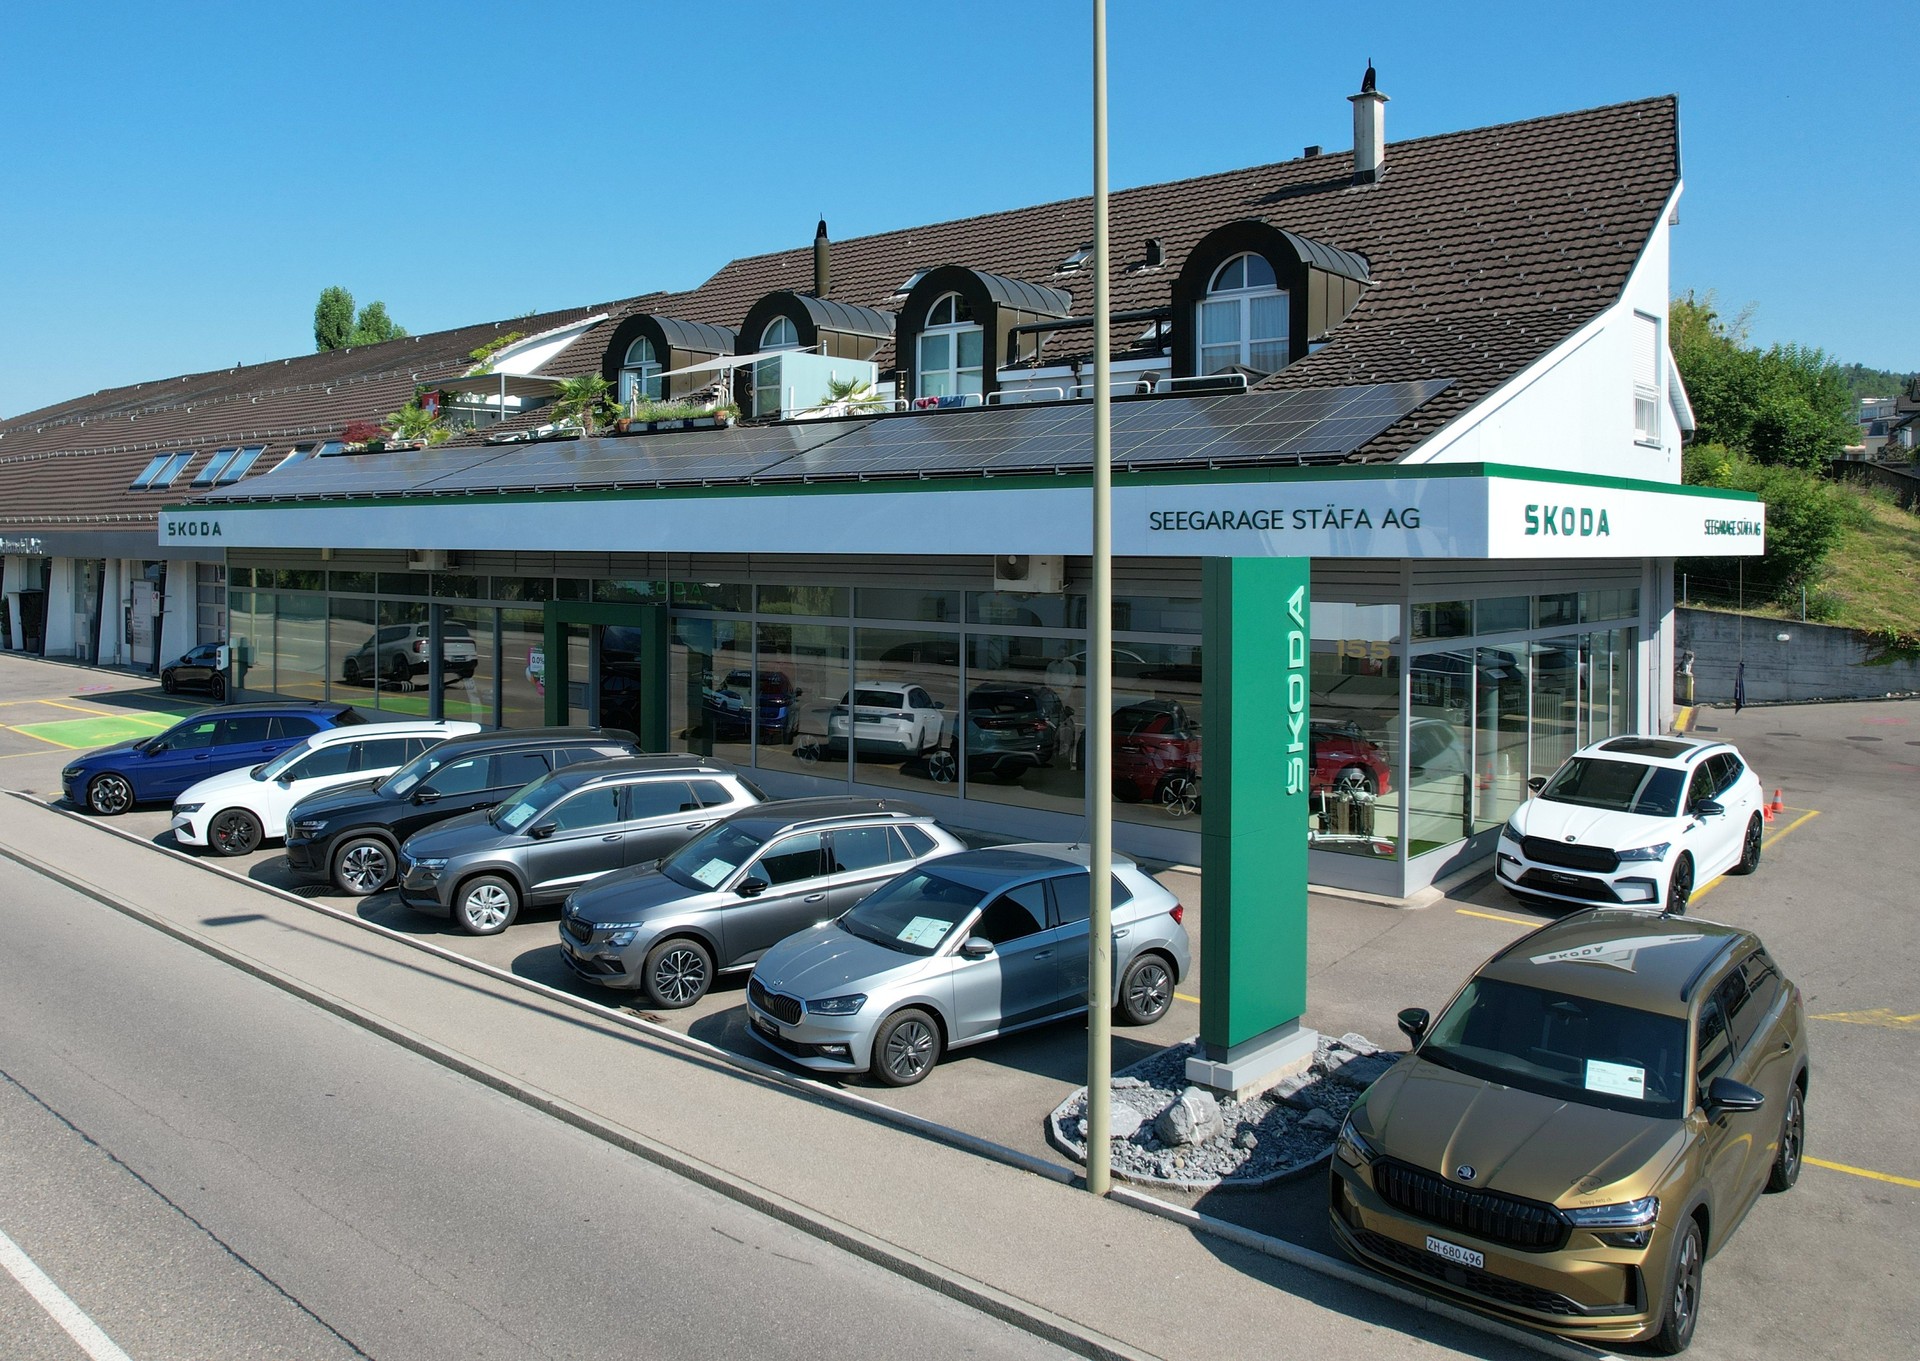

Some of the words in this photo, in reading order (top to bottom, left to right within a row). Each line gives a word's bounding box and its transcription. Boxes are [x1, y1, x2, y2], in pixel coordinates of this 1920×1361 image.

[168, 521, 222, 536] SKODA
[1149, 510, 1285, 531] SEEGARAGE
[1292, 503, 1373, 530] STÄFA
[1381, 507, 1421, 529] AG
[1524, 504, 1610, 537] SKODA
[1337, 639, 1391, 659] 155
[1286, 585, 1304, 795] SKODA
